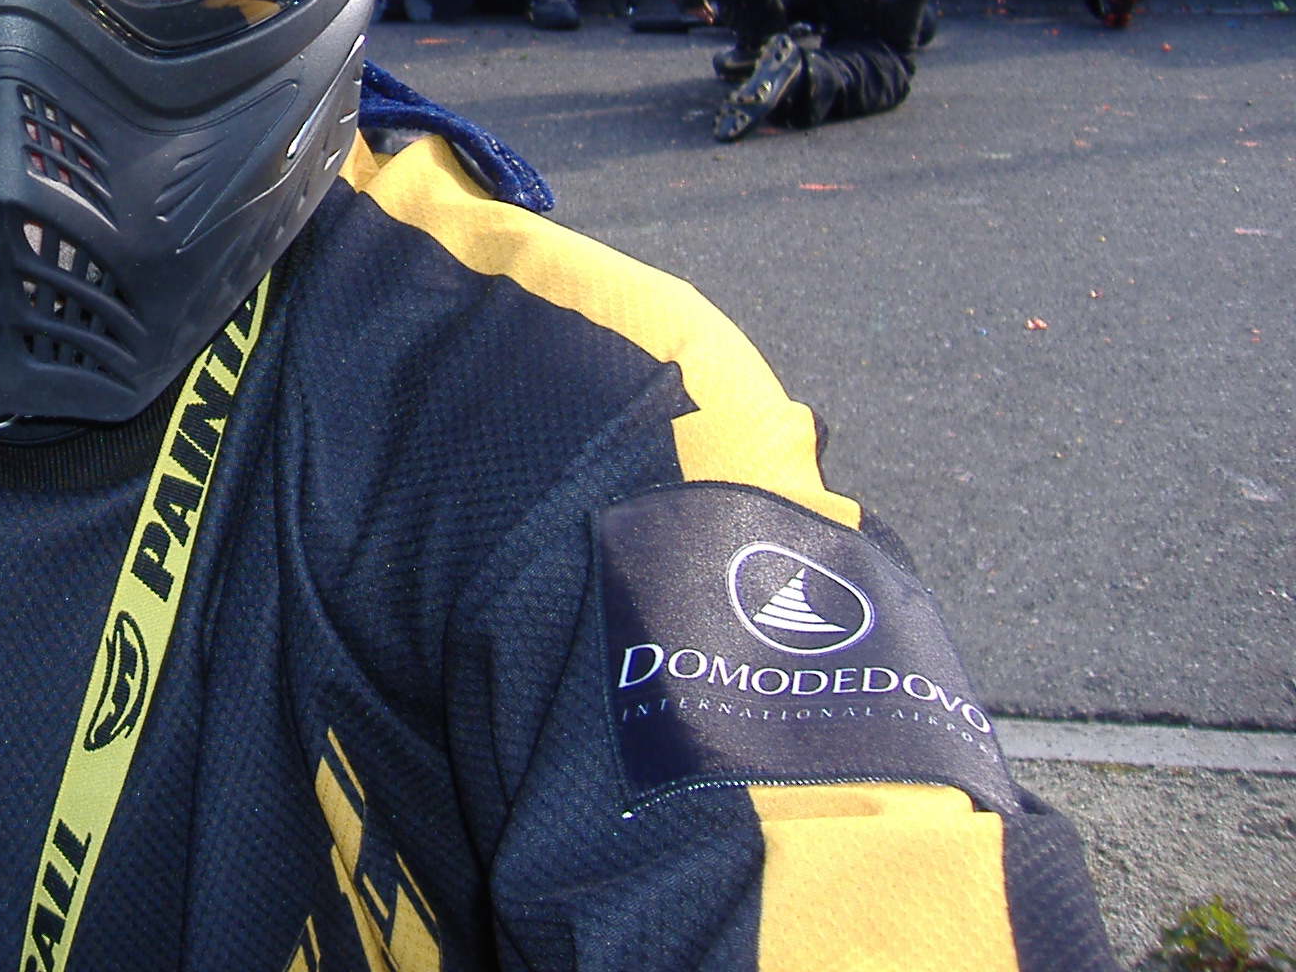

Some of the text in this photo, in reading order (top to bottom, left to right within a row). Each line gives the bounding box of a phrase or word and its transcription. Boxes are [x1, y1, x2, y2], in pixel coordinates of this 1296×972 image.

[618, 642, 993, 734] DOMODEDOVO
[621, 696, 874, 723] INTERNATIONAL
[24, 817, 92, 972] ALL
